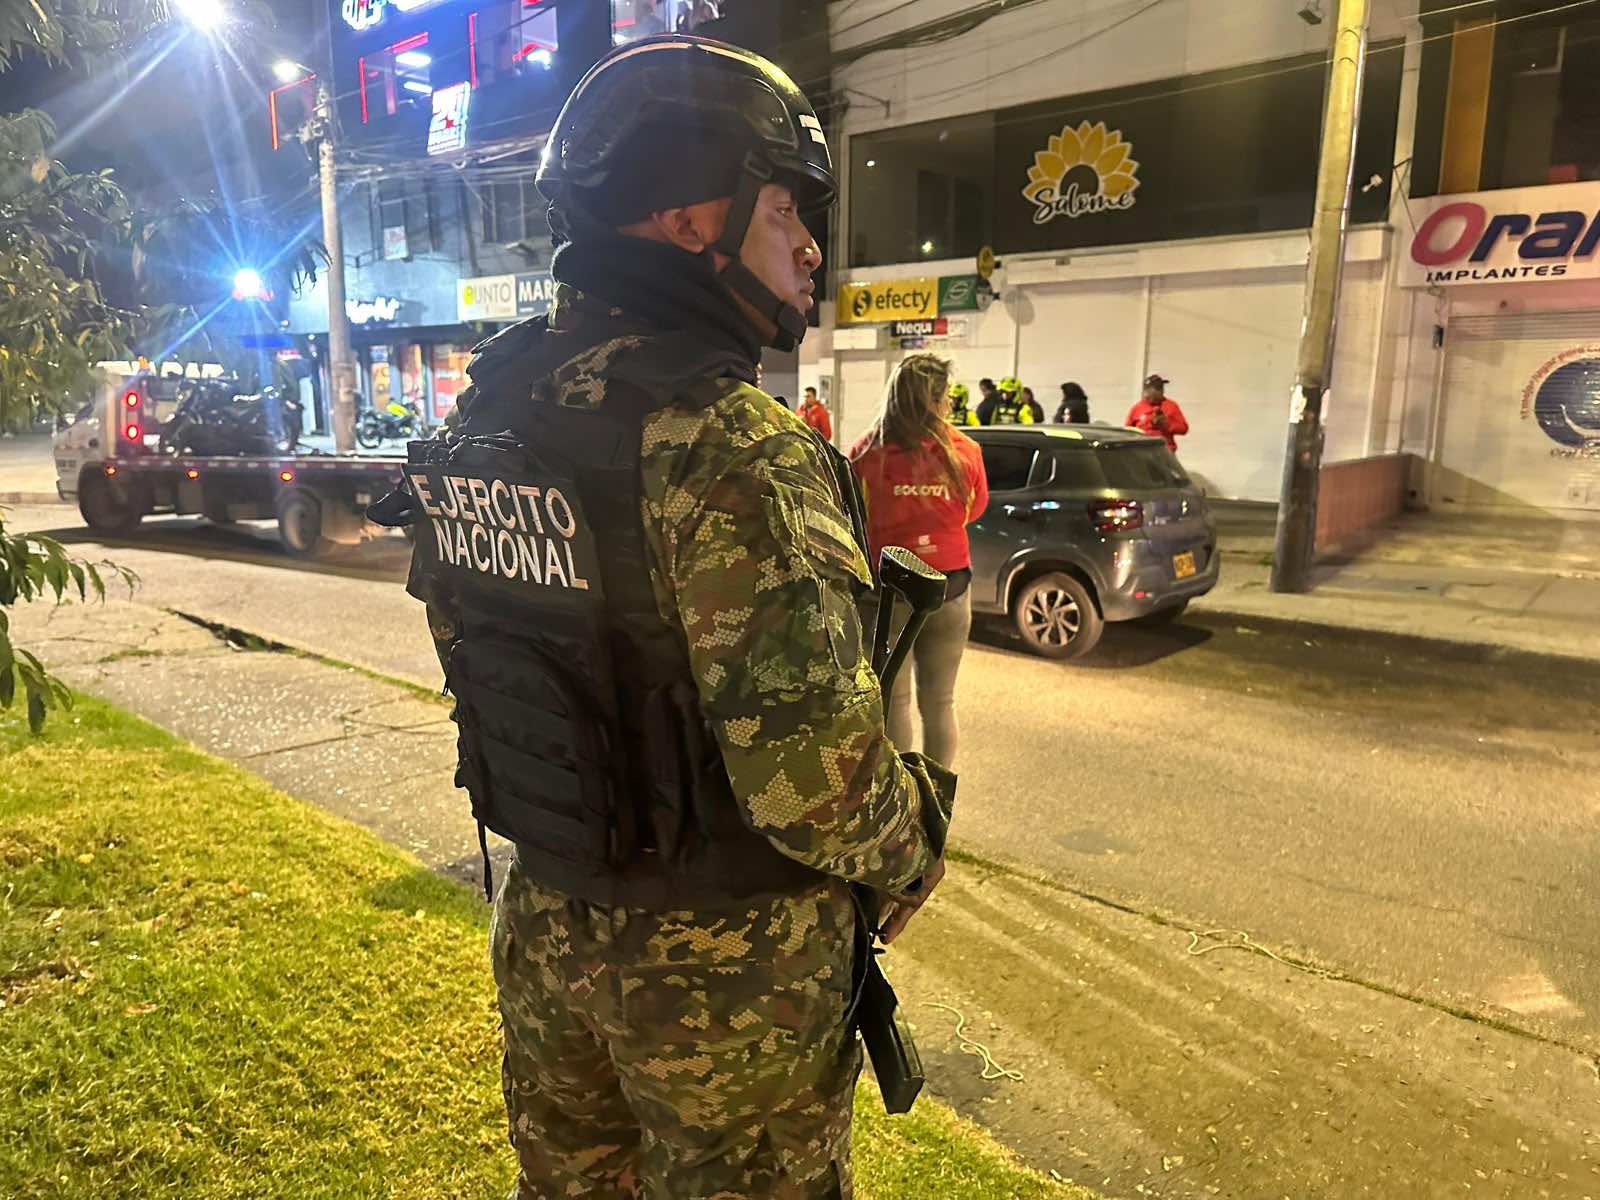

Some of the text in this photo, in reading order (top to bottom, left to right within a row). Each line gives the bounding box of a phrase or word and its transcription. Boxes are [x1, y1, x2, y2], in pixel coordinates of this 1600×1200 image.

[1426, 264, 1568, 283] IMPLANTES
[875, 287, 931, 314] efecty
[896, 321, 932, 336] Nequi
[409, 474, 577, 539] EJERCITO
[431, 517, 590, 591] NACIONAL
